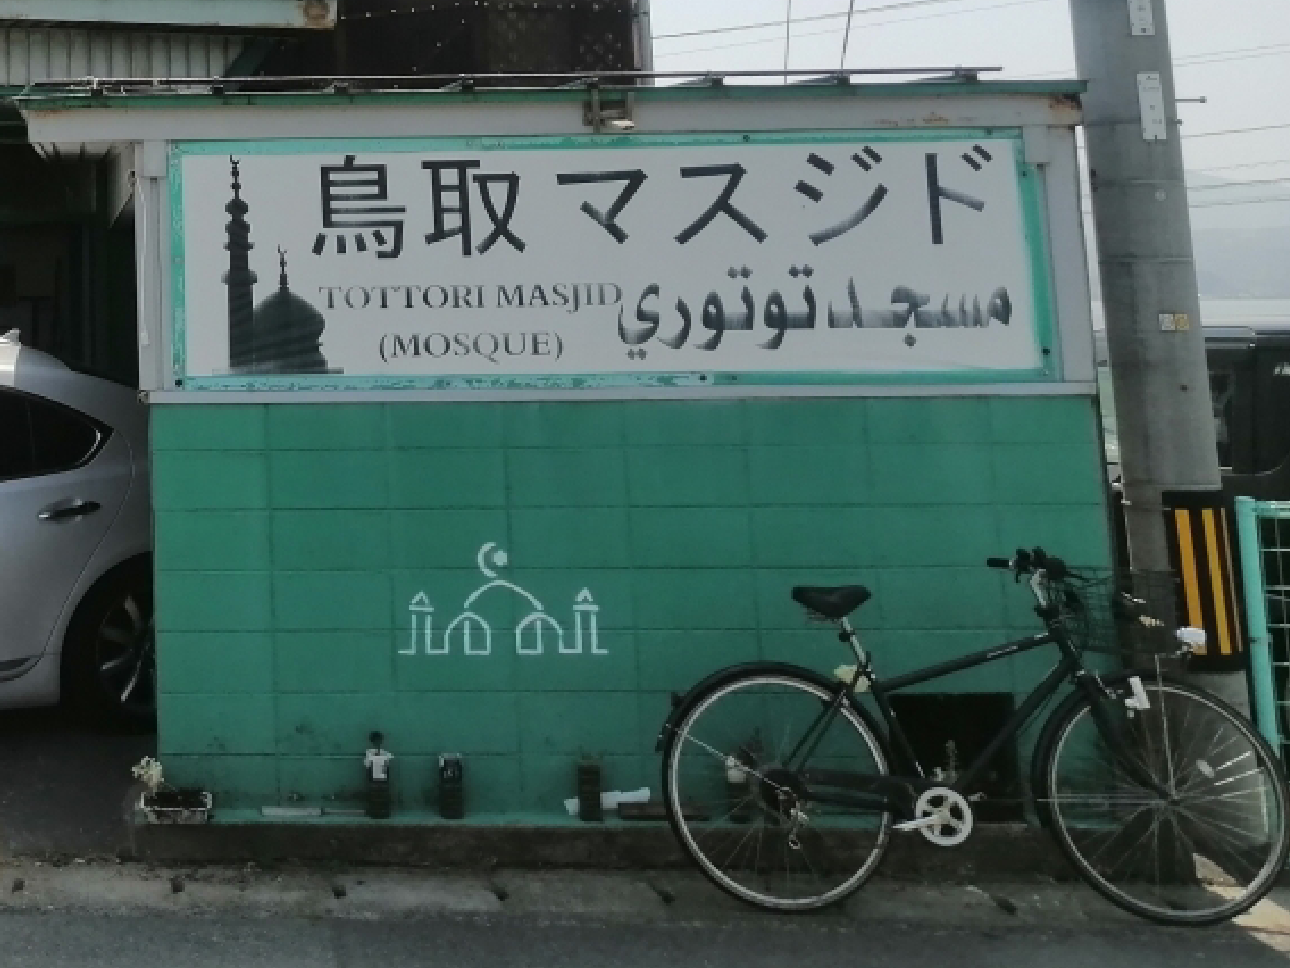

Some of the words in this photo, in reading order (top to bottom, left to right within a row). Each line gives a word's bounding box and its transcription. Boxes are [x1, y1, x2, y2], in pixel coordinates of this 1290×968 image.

[311, 145, 993, 259] 鳥取マスジド
[319, 284, 485, 310] TOTTORI
[496, 283, 623, 314] MASJID
[617, 264, 816, 360] توتوري
[827, 275, 1012, 349] مسجد
[379, 332, 564, 365] (MOSQUE)
